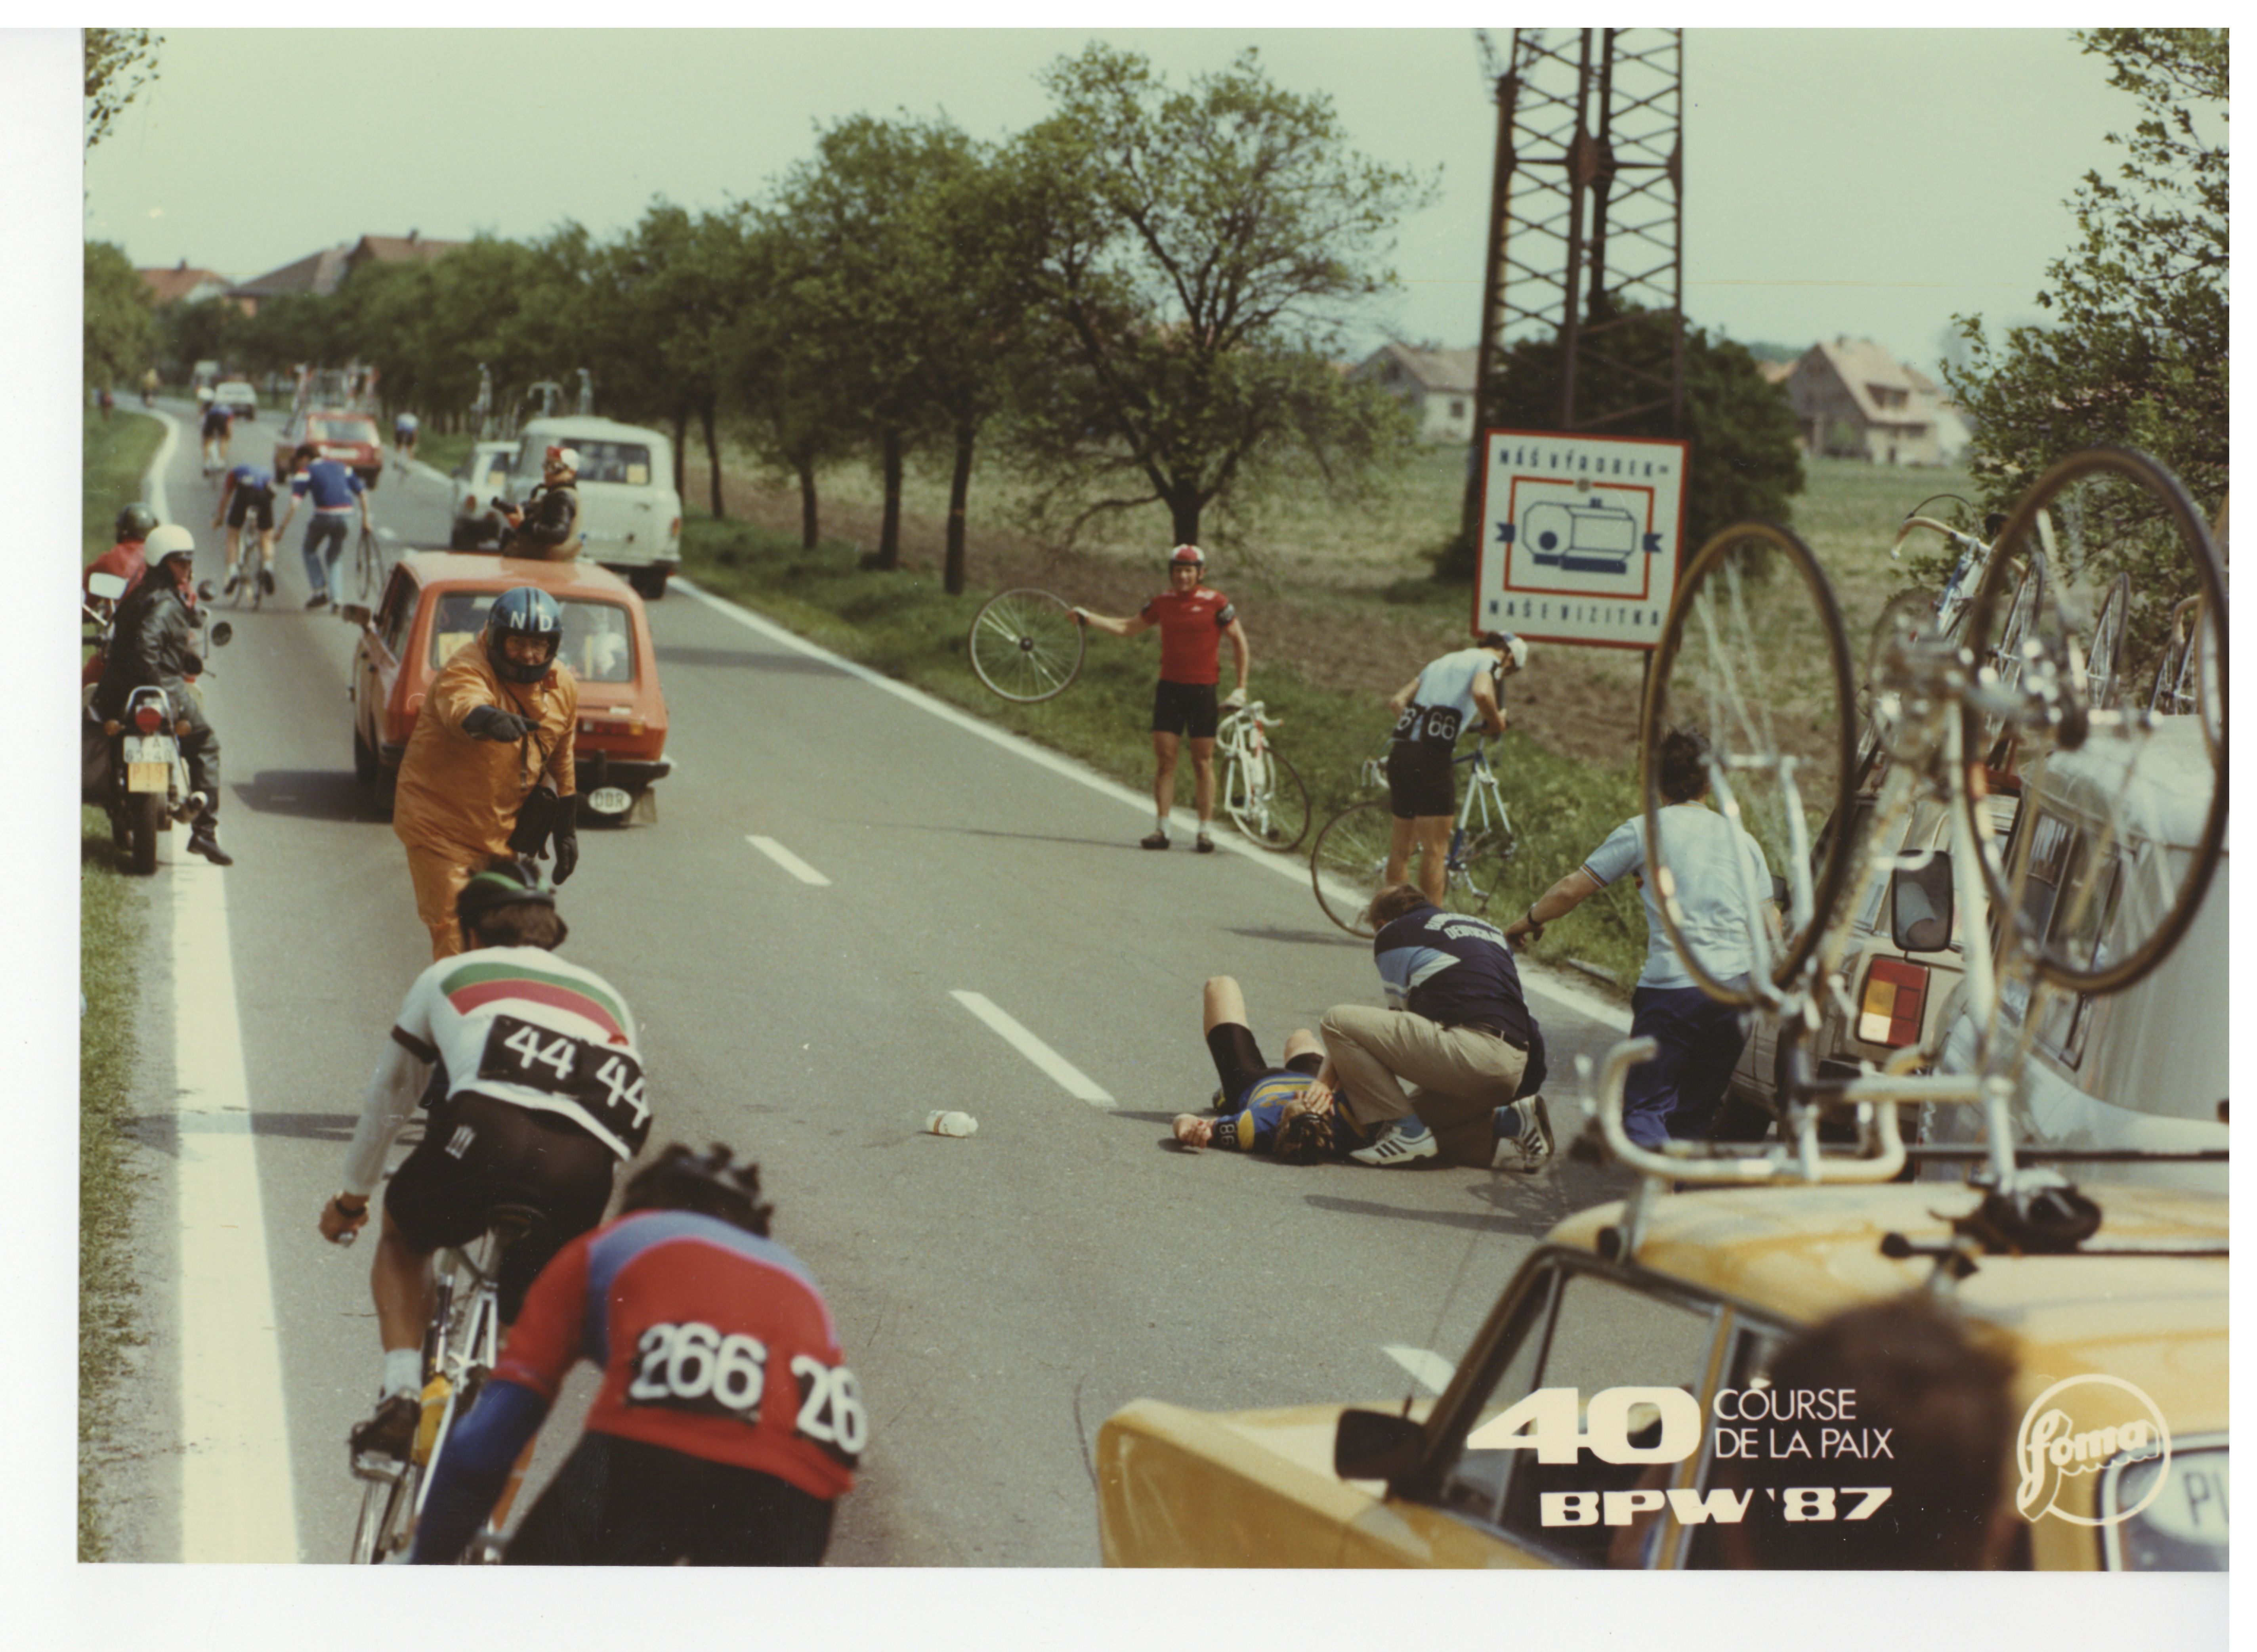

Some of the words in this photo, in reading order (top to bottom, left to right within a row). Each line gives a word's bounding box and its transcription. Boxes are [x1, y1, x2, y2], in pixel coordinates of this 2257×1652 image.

[1489, 598, 1548, 619] NAŠE
[1560, 604, 1658, 626] VIZITKA
[1428, 712, 1455, 740] 66
[595, 792, 624, 807] DDR
[504, 1026, 576, 1079] 44
[596, 1056, 649, 1129] 44
[629, 1322, 767, 1410] 266
